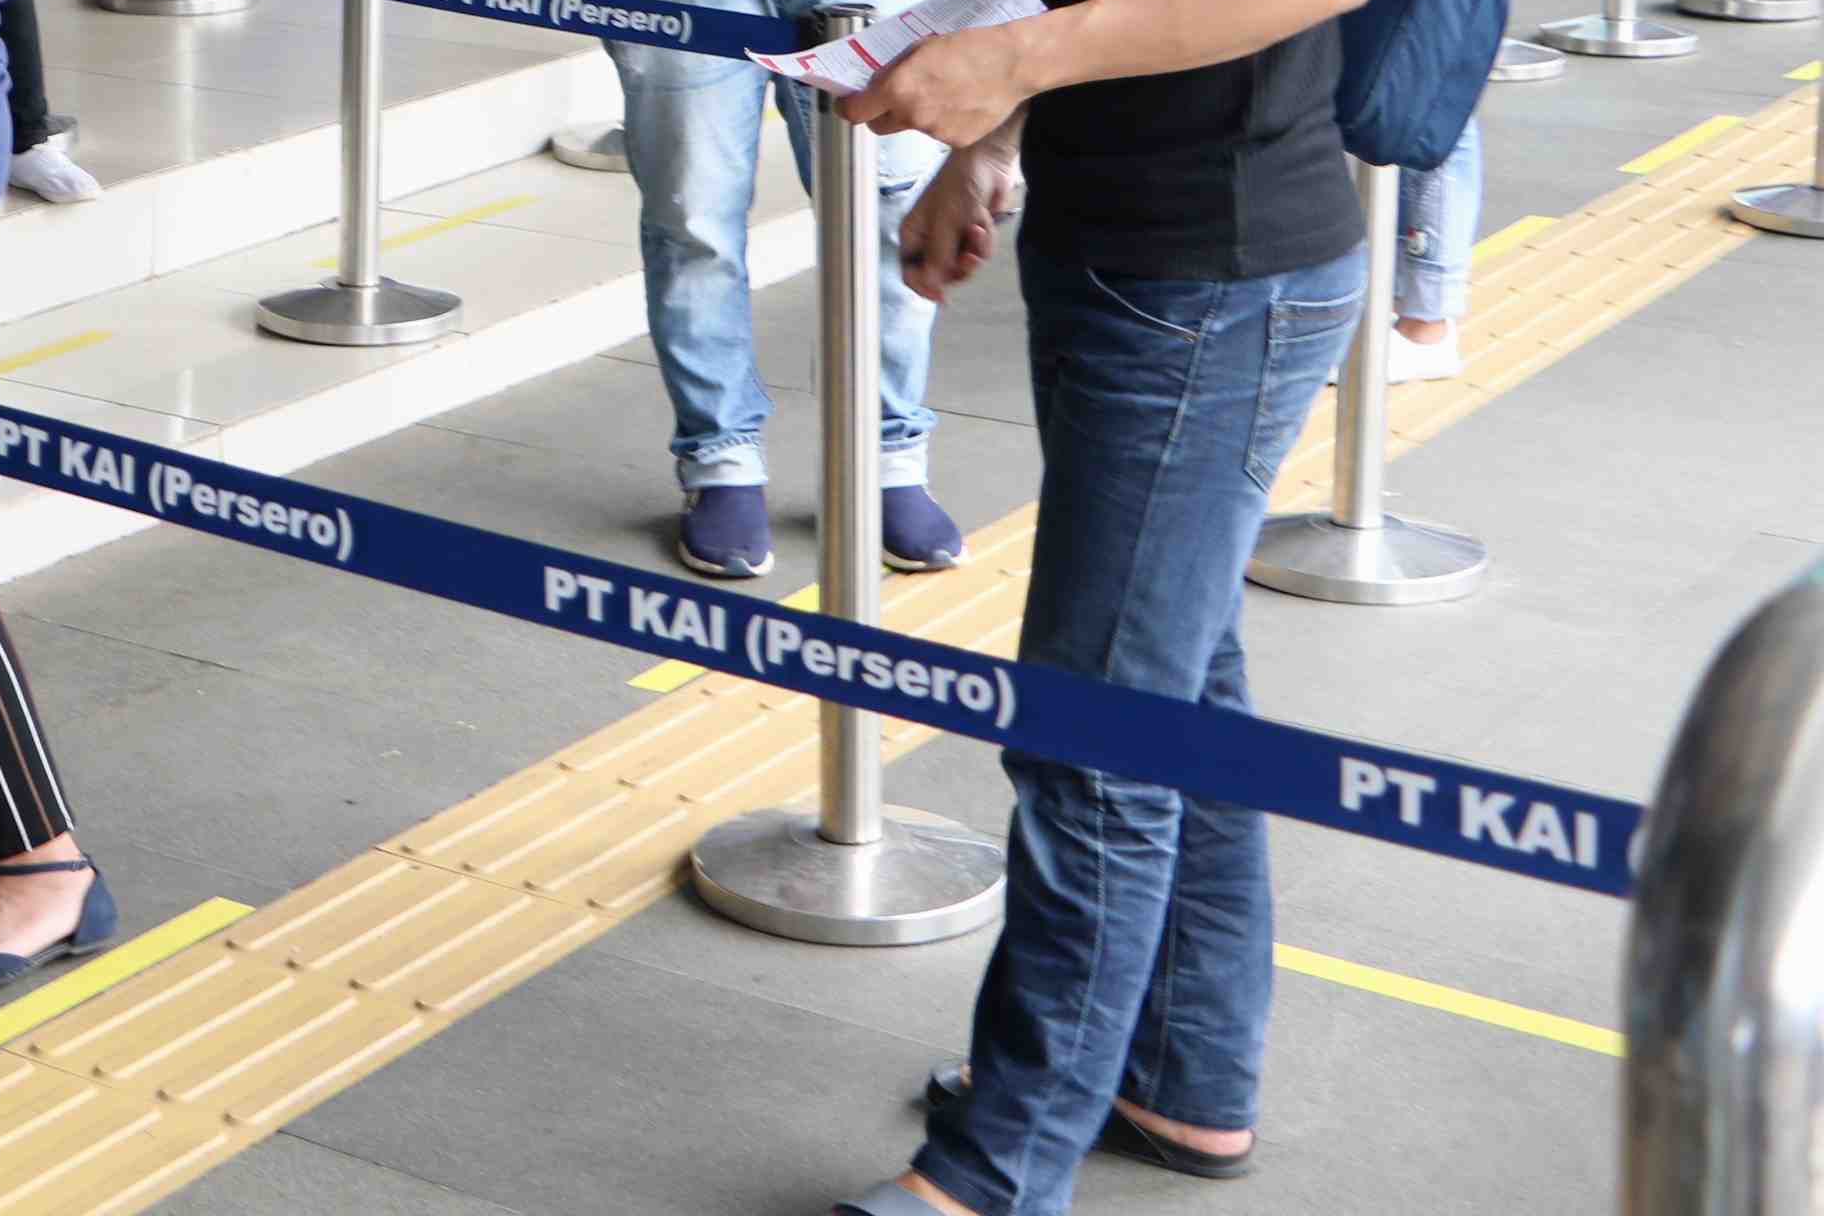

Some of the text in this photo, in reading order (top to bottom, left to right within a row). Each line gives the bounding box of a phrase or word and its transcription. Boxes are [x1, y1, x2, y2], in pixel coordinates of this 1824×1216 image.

[59, 438, 136, 498] KAI
[146, 459, 354, 562] (Persero)
[542, 565, 1017, 730] PT KAI (Persero)
[1338, 755, 1437, 827] PT
[1459, 785, 1598, 870] KAI
